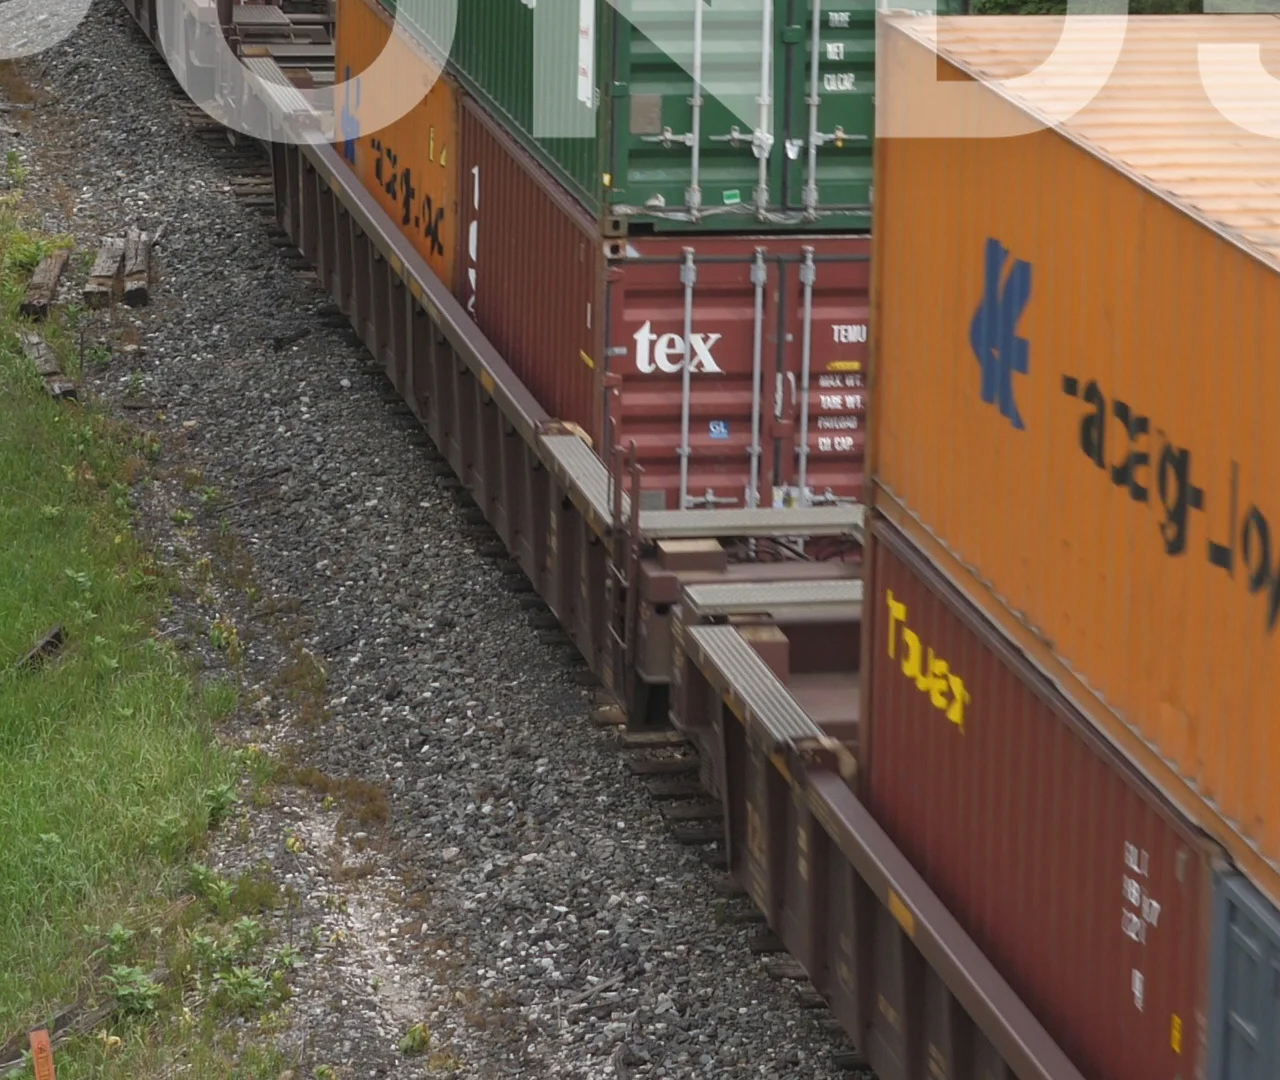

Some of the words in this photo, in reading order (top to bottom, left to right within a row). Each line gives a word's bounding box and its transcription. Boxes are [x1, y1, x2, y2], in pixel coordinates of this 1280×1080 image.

[826, 43, 845, 59] NET
[831, 325, 867, 342] TEMU
[633, 320, 726, 374] tex
